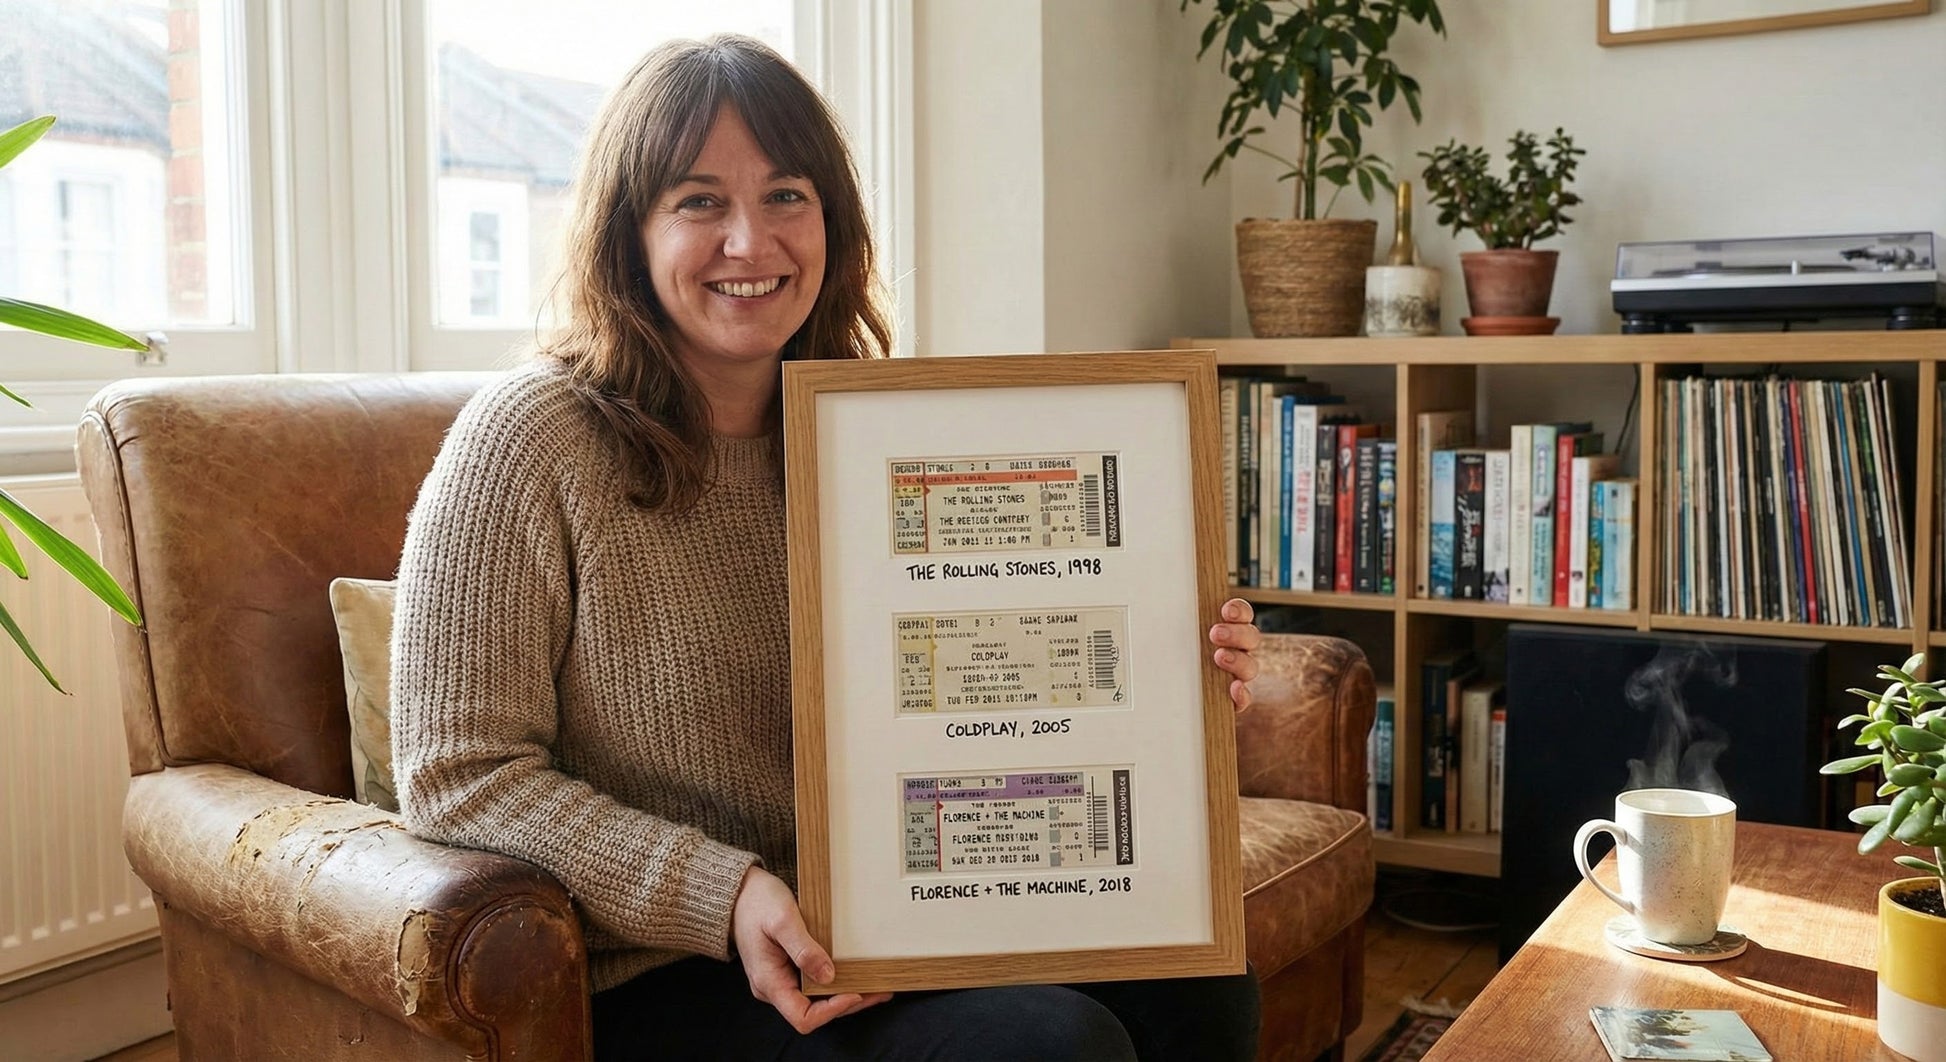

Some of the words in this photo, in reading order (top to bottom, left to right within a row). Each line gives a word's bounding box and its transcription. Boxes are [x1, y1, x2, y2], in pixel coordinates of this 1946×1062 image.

[943, 496, 957, 506] THE
[961, 495, 994, 505] ROLLING
[997, 494, 1025, 504] STONES
[940, 517, 954, 526] THE
[906, 564, 937, 581] THE
[942, 562, 999, 579] ROLLING
[1005, 561, 1062, 578] STONES,
[1068, 558, 1102, 575] 1998
[946, 721, 1025, 738] COLDPLAY,
[1032, 719, 1072, 734] 2005
[944, 812, 981, 823] FLORENCE
[994, 811, 1008, 821] THE
[1013, 810, 1045, 820] MACHINE
[952, 834, 991, 844] FLORENCE
[911, 884, 979, 901] FLORENCE
[984, 886, 993, 895] +
[996, 882, 1021, 896] THE
[1028, 879, 1094, 896] MACHINE,
[1099, 877, 1131, 892] 2018
